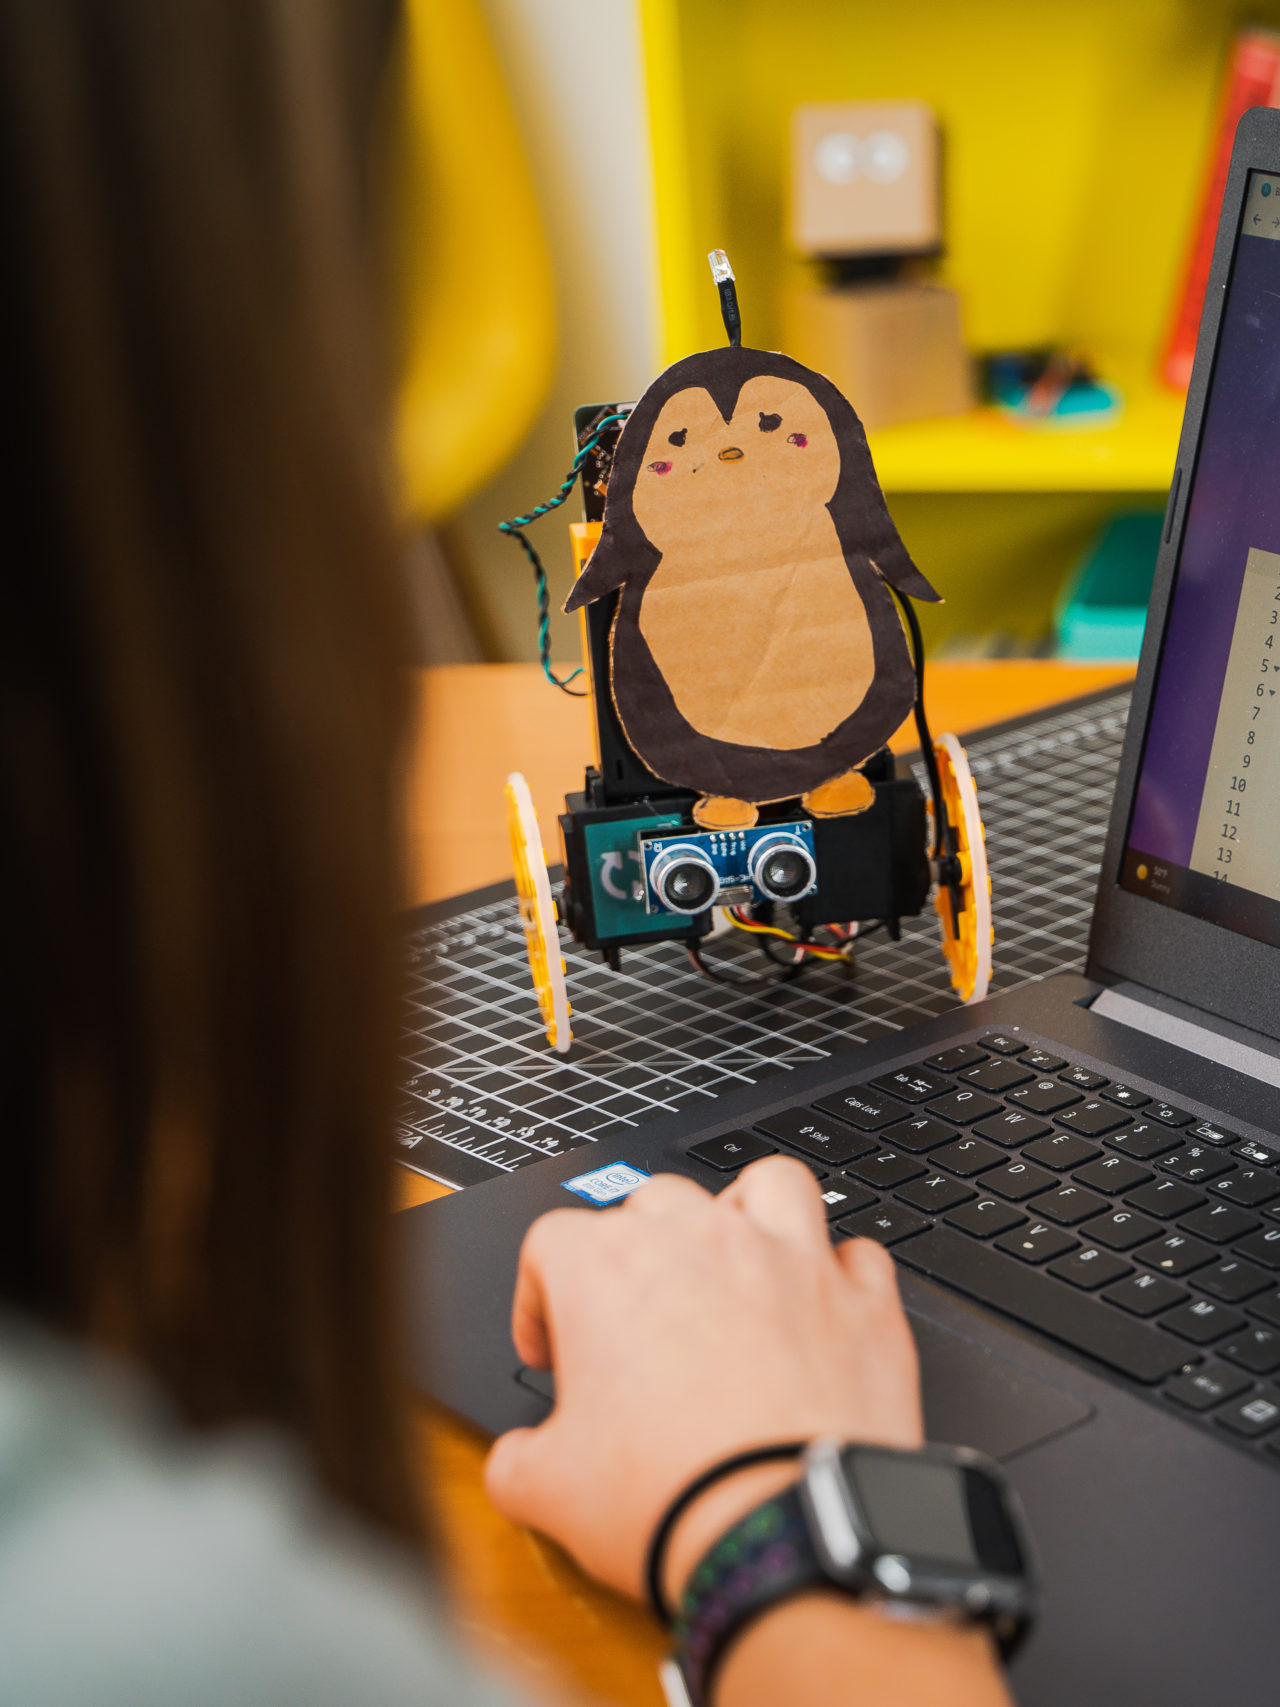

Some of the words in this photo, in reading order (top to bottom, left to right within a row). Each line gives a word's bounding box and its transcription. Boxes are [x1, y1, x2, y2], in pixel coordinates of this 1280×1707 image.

[1269, 610, 1278, 625] 3
[1264, 634, 1274, 650] 4
[1261, 658, 1269, 673] 5
[1255, 682, 1264, 698] 6
[1252, 706, 1261, 721] 7
[1246, 730, 1256, 746] 8
[1242, 754, 1251, 769] 9
[1229, 775, 1247, 793] 10
[1225, 799, 1241, 817] 11
[1220, 823, 1238, 841] 12
[1216, 847, 1233, 864] 13
[894, 1074, 909, 1082] Tab
[957, 1093, 973, 1101] Q
[845, 1098, 864, 1107] Caps
[861, 1105, 880, 1115] Lock
[1005, 1113, 1026, 1123] W
[809, 1131, 830, 1142] Shift
[1052, 1136, 1069, 1144] E
[1114, 1134, 1128, 1142] 4
[878, 1154, 896, 1162] Z
[1103, 1159, 1119, 1167] R
[926, 1177, 945, 1186] X
[1158, 1182, 1173, 1190] T
[978, 1202, 995, 1210] C
[1211, 1206, 1227, 1214] Y
[1113, 1213, 1131, 1222] G
[1030, 1225, 1047, 1234] V
[1166, 1237, 1184, 1247] H
[1135, 1276, 1155, 1287] N
[1192, 1302, 1214, 1314] M
